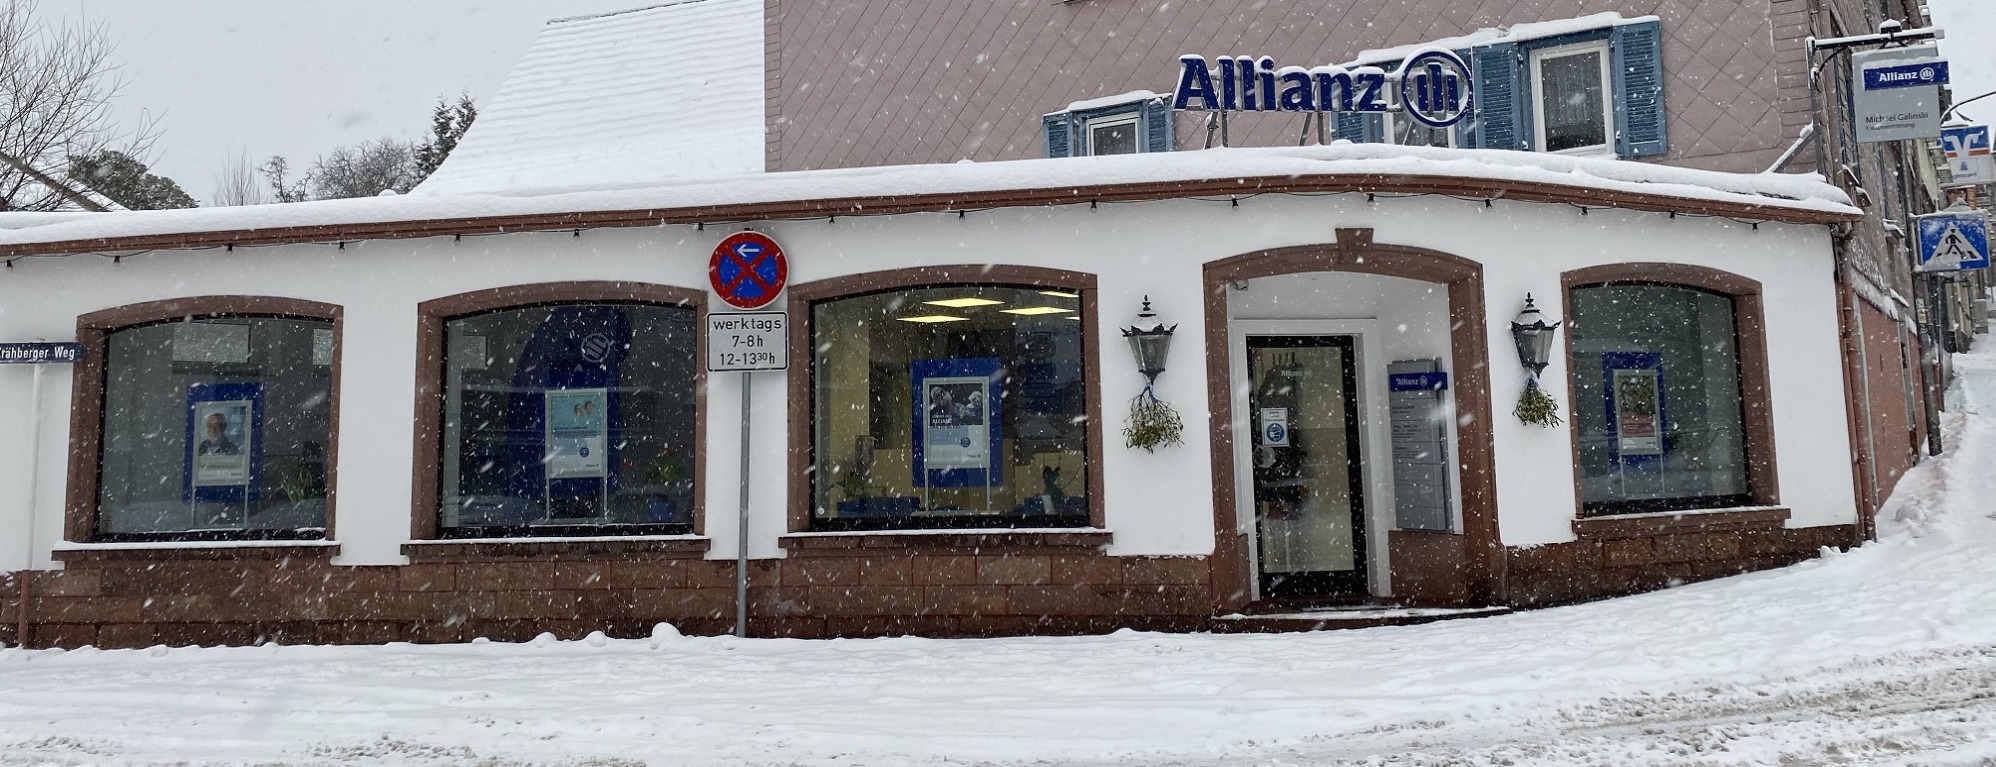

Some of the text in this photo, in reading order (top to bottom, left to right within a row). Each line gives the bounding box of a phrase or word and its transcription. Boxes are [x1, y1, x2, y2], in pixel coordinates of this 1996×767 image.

[1172, 55, 1387, 112] Allianz
[1879, 71, 1918, 82] Allianz
[1866, 112, 1928, 123] Michel Galinski
[713, 318, 782, 332] werktags
[0, 346, 75, 361] rähberger Weg
